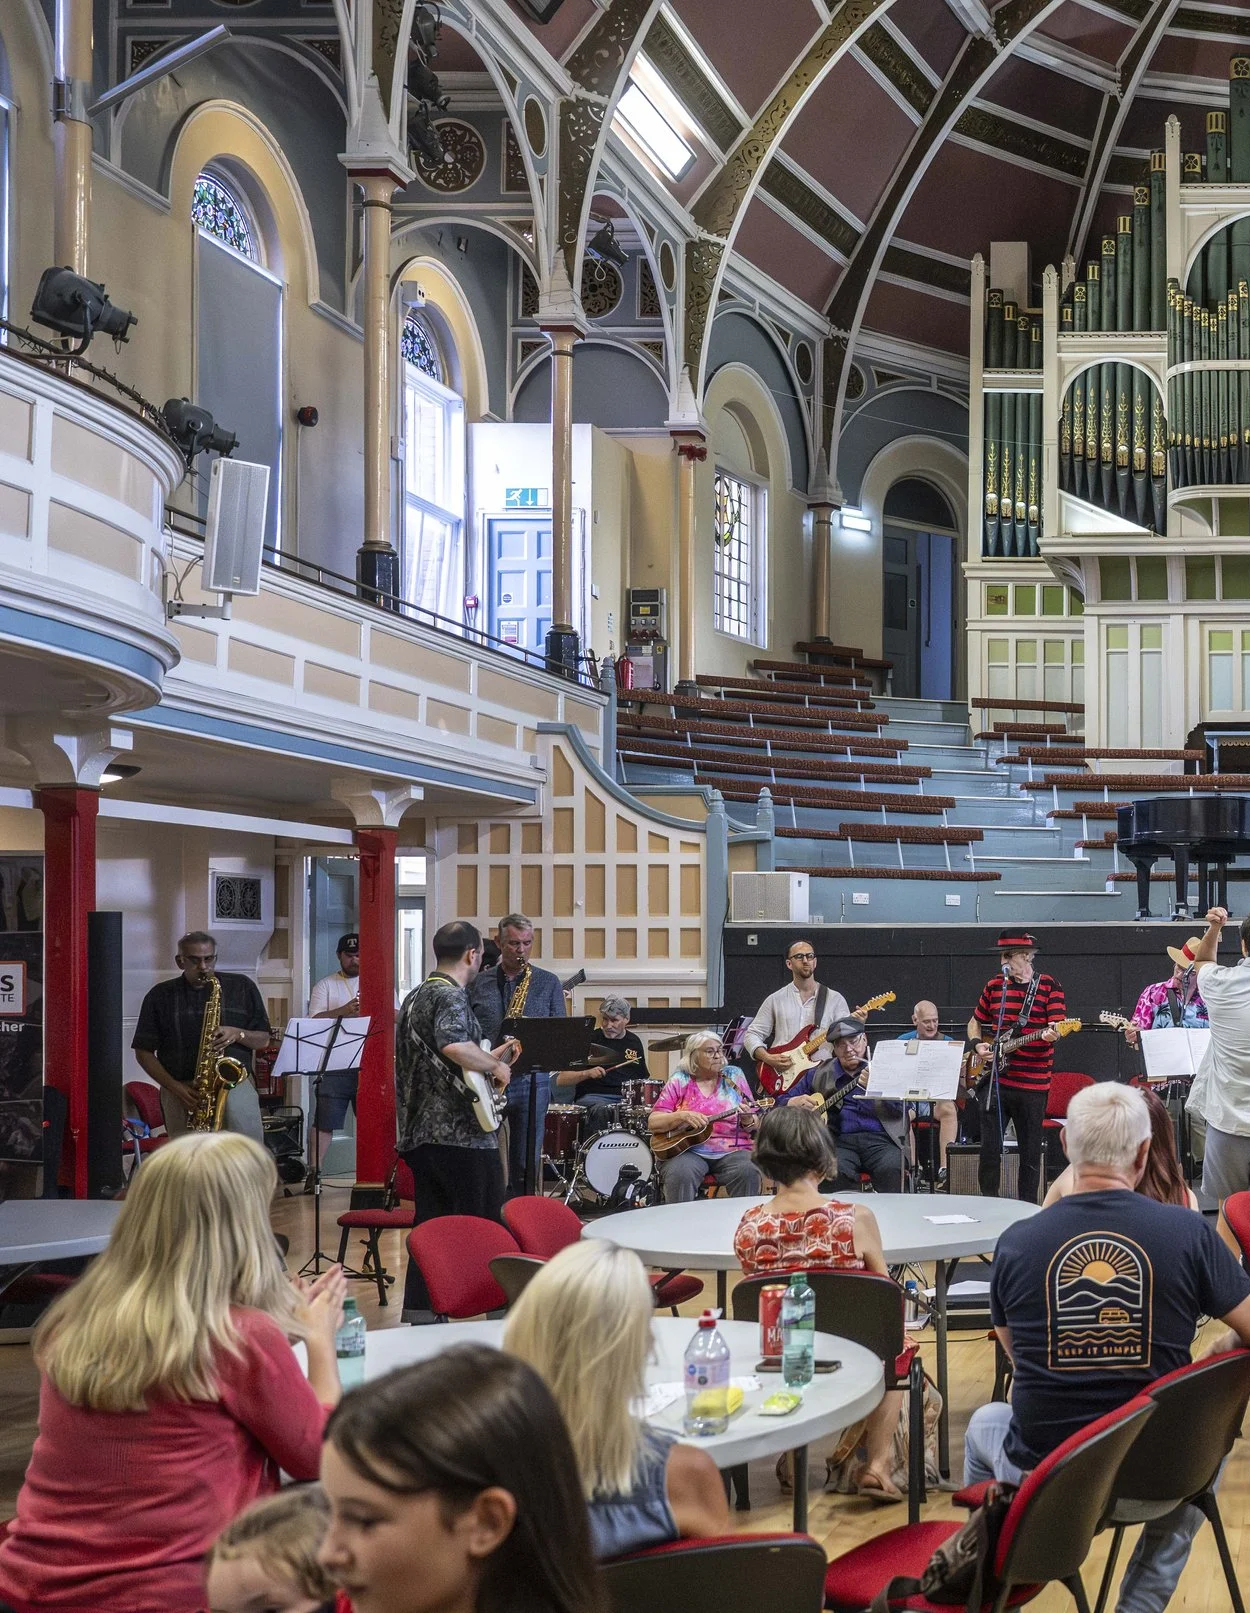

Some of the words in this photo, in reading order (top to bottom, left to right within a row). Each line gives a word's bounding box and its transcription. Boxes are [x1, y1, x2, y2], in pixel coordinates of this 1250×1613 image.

[0, 1021, 25, 1032] her
[1057, 1348, 1083, 1356] KEEP
[1087, 1346, 1098, 1355] IT
[1103, 1345, 1142, 1355] SIMPLE
